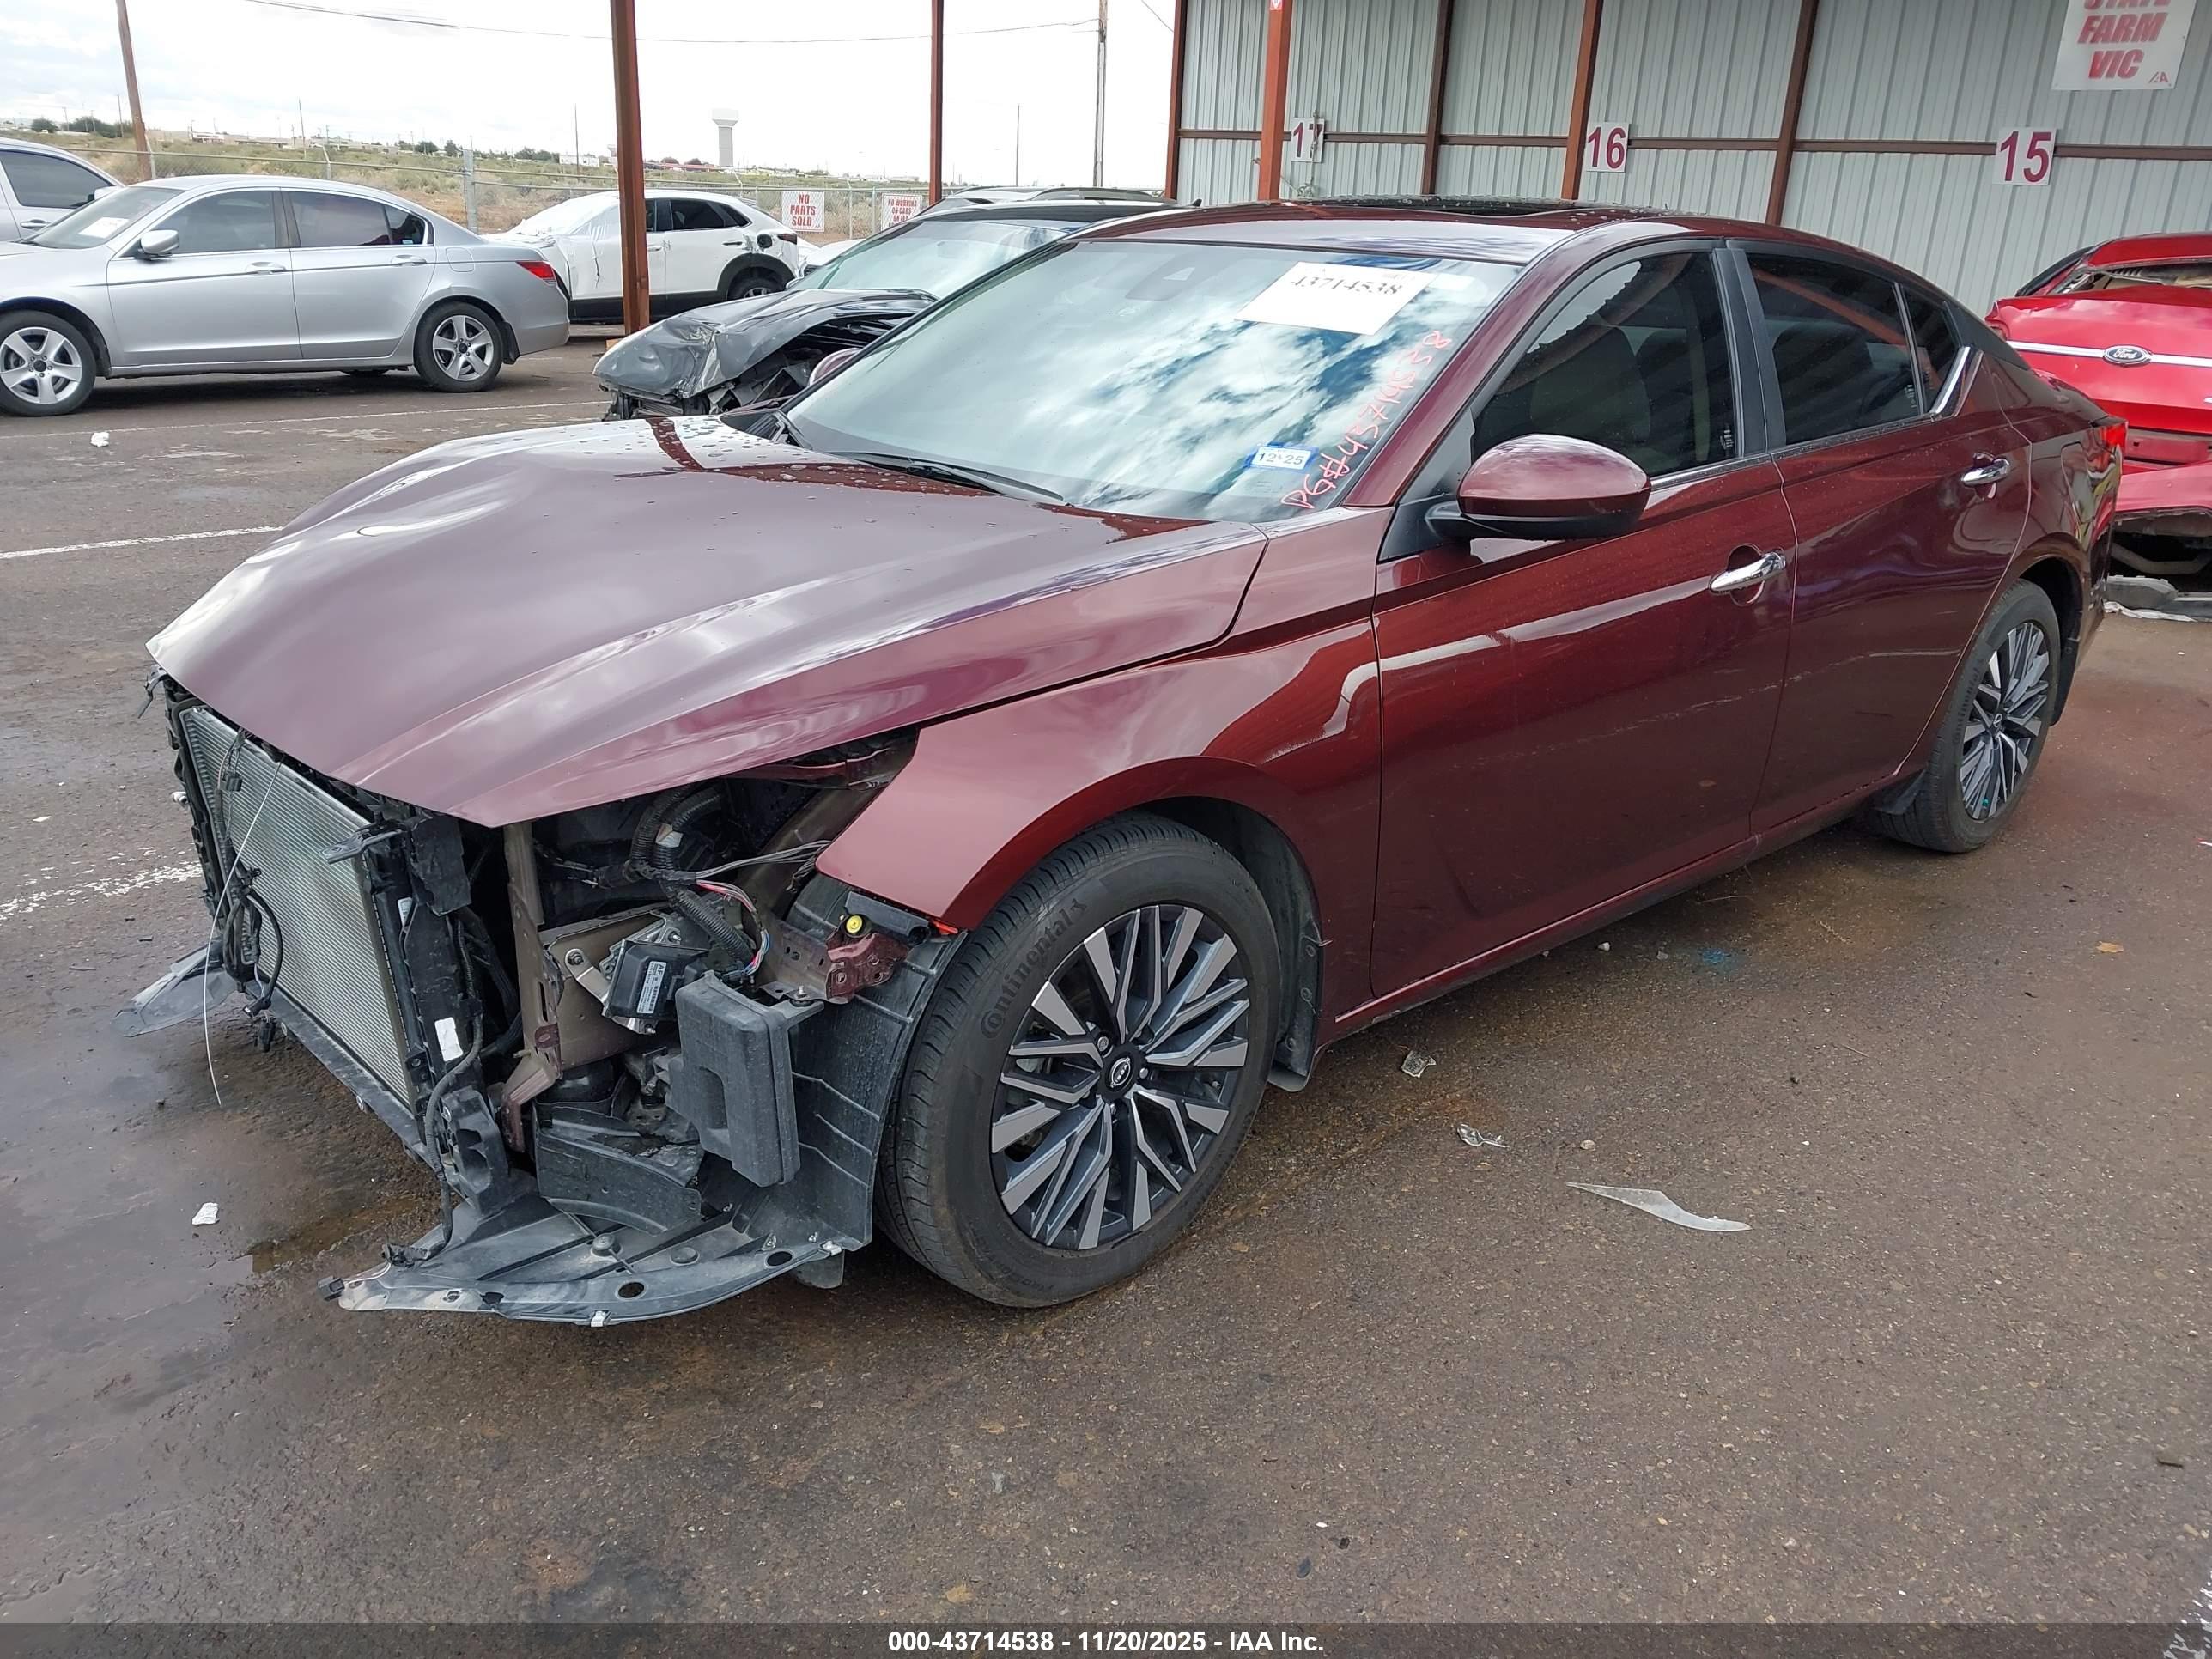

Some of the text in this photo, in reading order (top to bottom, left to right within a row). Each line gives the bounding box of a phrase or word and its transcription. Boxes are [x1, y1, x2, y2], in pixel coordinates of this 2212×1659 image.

[2077, 12, 2168, 44] FARM
[2088, 49, 2144, 79] VIC
[1293, 122, 1323, 158] 17
[1588, 127, 1626, 168] 16
[2000, 131, 2051, 182] 15
[798, 194, 810, 204] NO
[790, 205, 816, 215] PARTS
[792, 217, 812, 226] SOLD
[2113, 349, 2137, 359] Ford
[1259, 453, 1304, 465] 12 25
